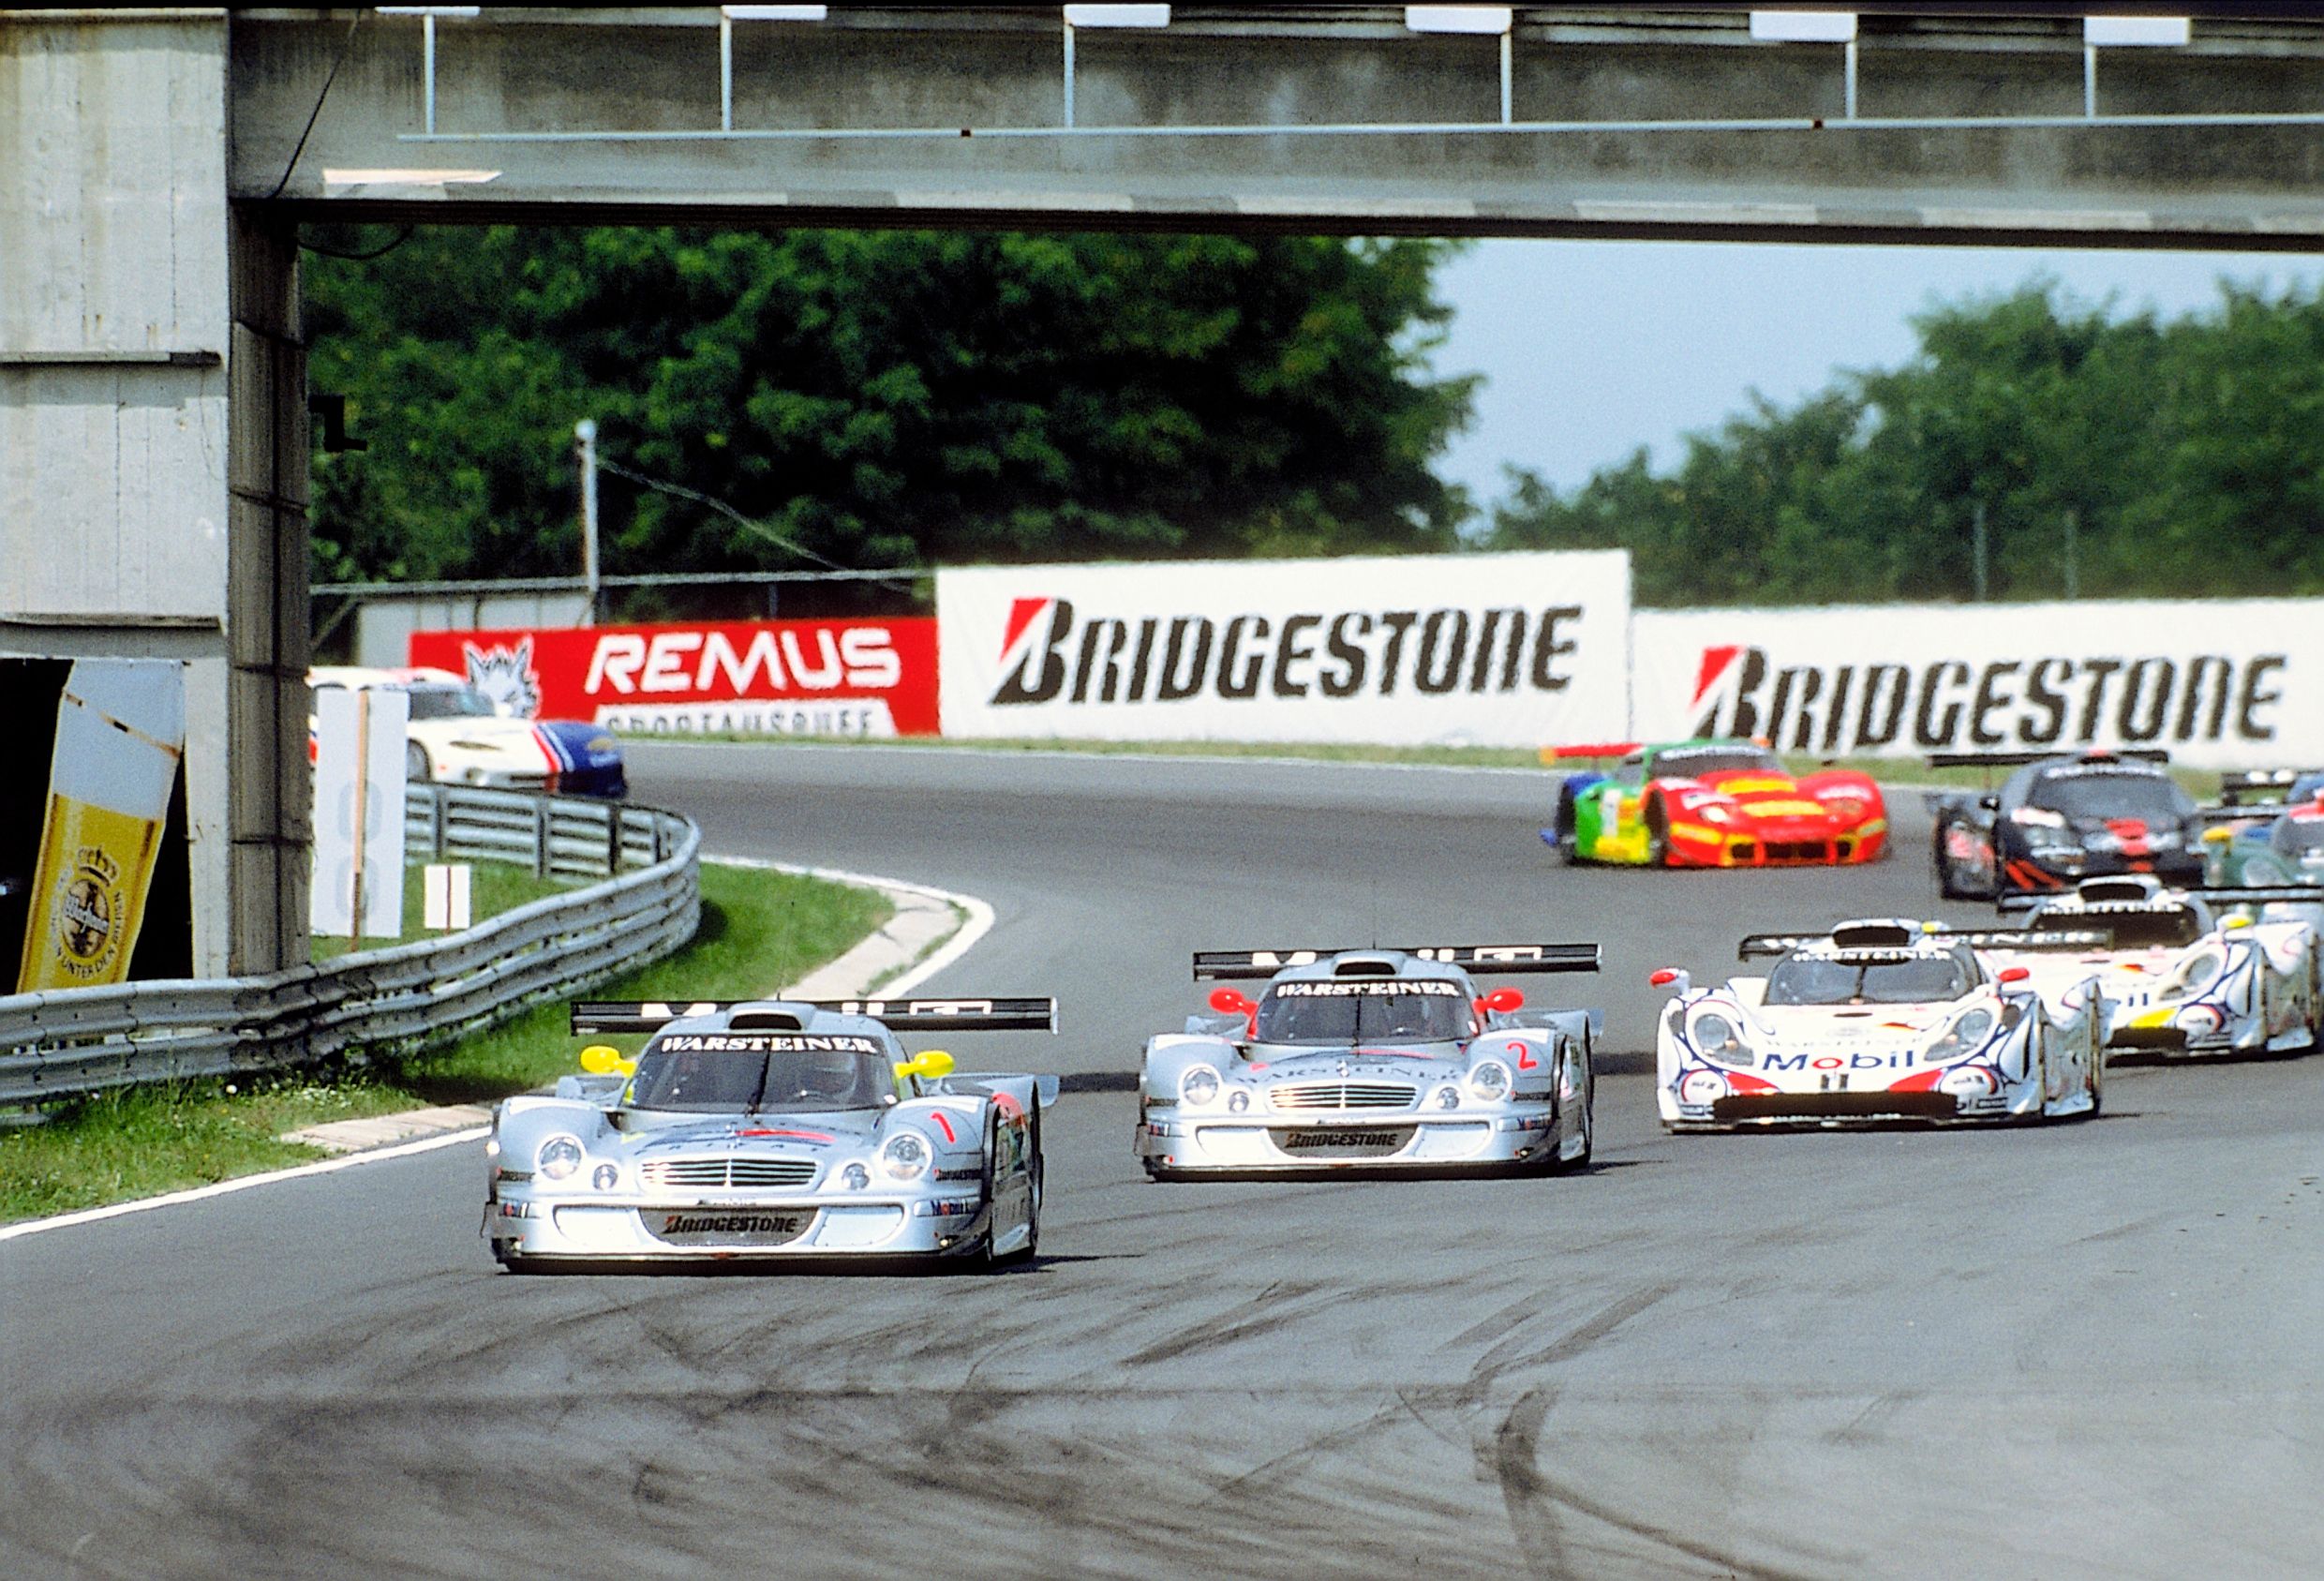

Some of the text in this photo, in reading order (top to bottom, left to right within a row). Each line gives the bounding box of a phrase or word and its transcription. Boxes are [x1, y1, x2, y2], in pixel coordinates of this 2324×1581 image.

[584, 627, 902, 695] REMUS
[989, 597, 1584, 706] BRIDGESTONE
[1690, 645, 2289, 753] BRIDGESTONE
[1276, 981, 1460, 998] WARSTEINER
[661, 1036, 879, 1055] WARSTEINER
[1506, 1041, 1539, 1070] 2
[1762, 1050, 1914, 1071] Mobil
[930, 1111, 957, 1144] 1
[1285, 1131, 1399, 1149] BRIDGESTONE
[662, 1214, 797, 1234] BRIDGESTONE
